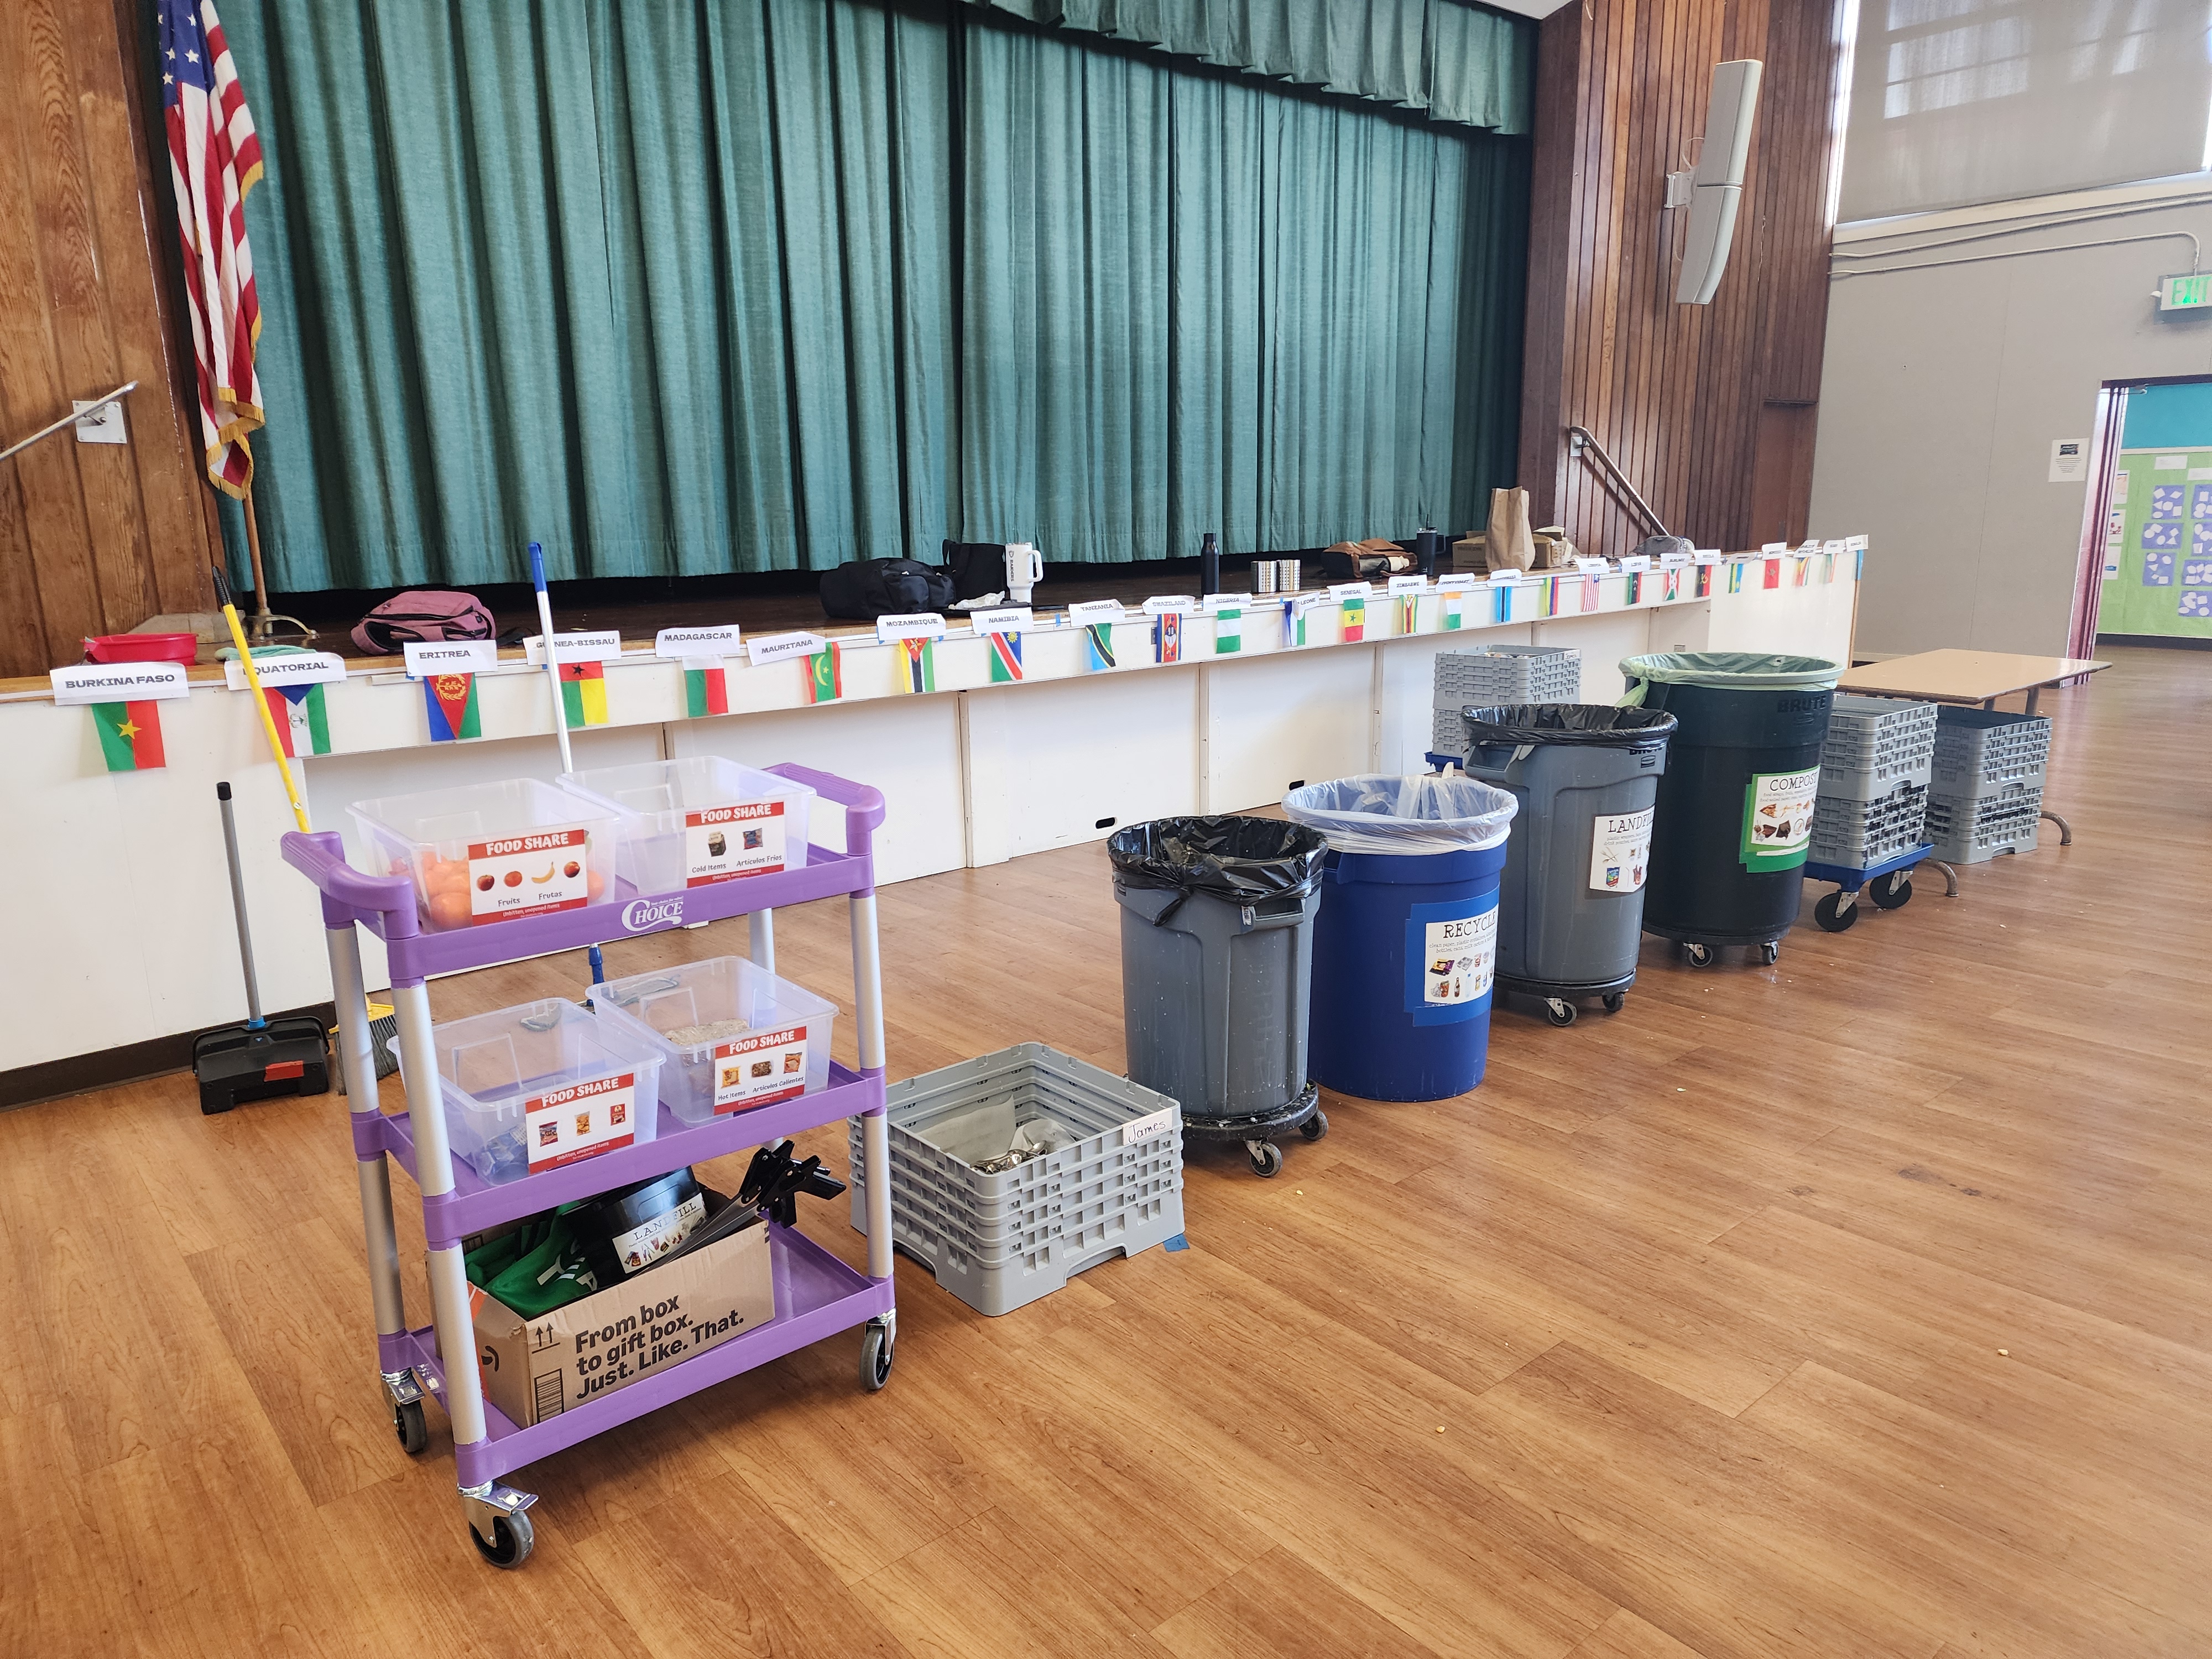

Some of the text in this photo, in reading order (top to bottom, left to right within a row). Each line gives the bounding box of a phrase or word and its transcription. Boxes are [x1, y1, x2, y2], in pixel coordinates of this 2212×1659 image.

[2171, 276, 2212, 305] EXIT
[1080, 603, 1114, 612] TANZANIA
[886, 618, 938, 627] MOZAMBIQUE
[988, 615, 1020, 624] NAMIBIA
[536, 638, 615, 648] GNEA-BISSAU
[664, 633, 732, 641] MADAGASCAR
[419, 650, 471, 659] ERITREA
[761, 639, 813, 654] MAURITANA
[65, 674, 175, 688] BURKINA FASO
[1777, 695, 1827, 713] BRUTE
[1770, 771, 1818, 791] COMPOST
[701, 804, 771, 823] FOOD SHARE
[1608, 810, 1654, 833] LANDFIL
[486, 833, 569, 855] FOOD SHARE
[692, 863, 726, 873] Cold Items
[498, 898, 520, 907] Fruits
[539, 891, 562, 901] Frutas
[525, 905, 546, 913] unopened
[622, 900, 684, 932] CHOICE
[1443, 911, 1496, 938] RECYCLE
[729, 1030, 795, 1055] FOOD SHARE
[779, 1076, 804, 1087] Calientes
[541, 1078, 619, 1108] FOOD SHARE
[729, 1090, 746, 1098] Items
[1128, 1120, 1167, 1144] James
[556, 1152, 577, 1161] Unbitten,
[576, 1144, 597, 1154] unopened
[633, 1202, 697, 1241] LANDFILL
[575, 1295, 680, 1354] From box
[576, 1313, 693, 1376] to gift box.
[576, 1309, 744, 1399] Just. Like. That.
